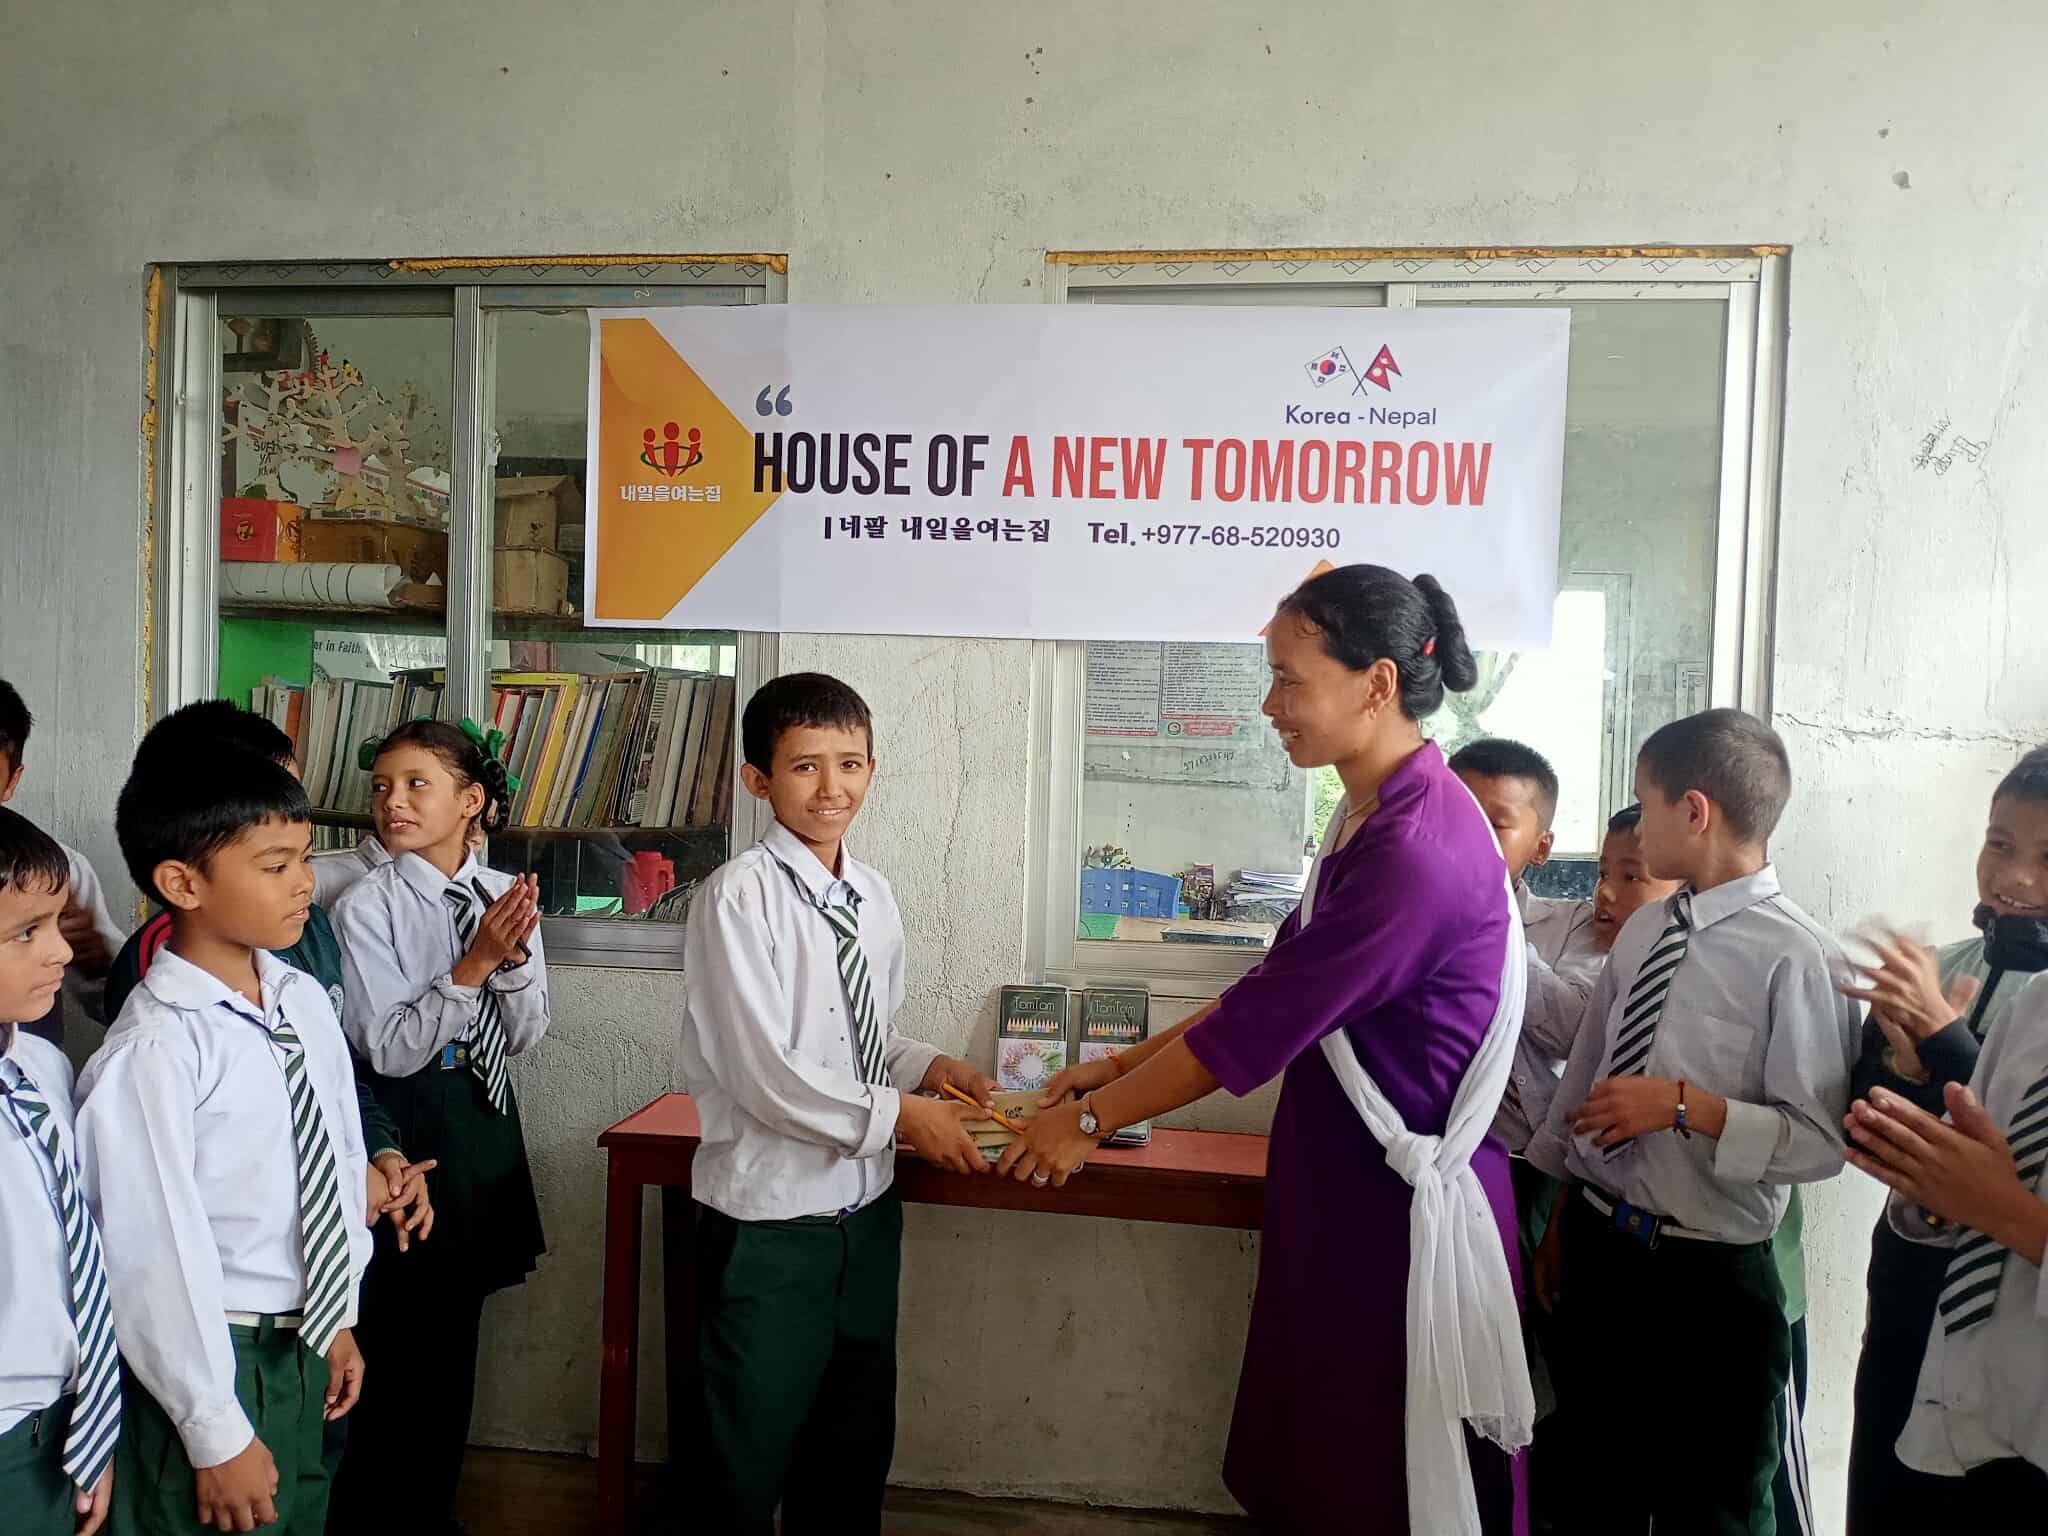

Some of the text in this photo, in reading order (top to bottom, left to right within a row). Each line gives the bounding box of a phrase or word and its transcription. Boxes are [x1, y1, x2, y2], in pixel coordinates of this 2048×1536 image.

[1285, 404, 1350, 424] Korea
[1369, 407, 1437, 429] Nepal
[753, 432, 1493, 506] HOUSE OF A NEW TOMORROW
[619, 484, 721, 502] 내일을여는집
[839, 515, 1051, 542] 네팔 내일을여는집
[1088, 522, 1340, 548] Tel. +977-68-520930
[326, 640, 335, 652] in
